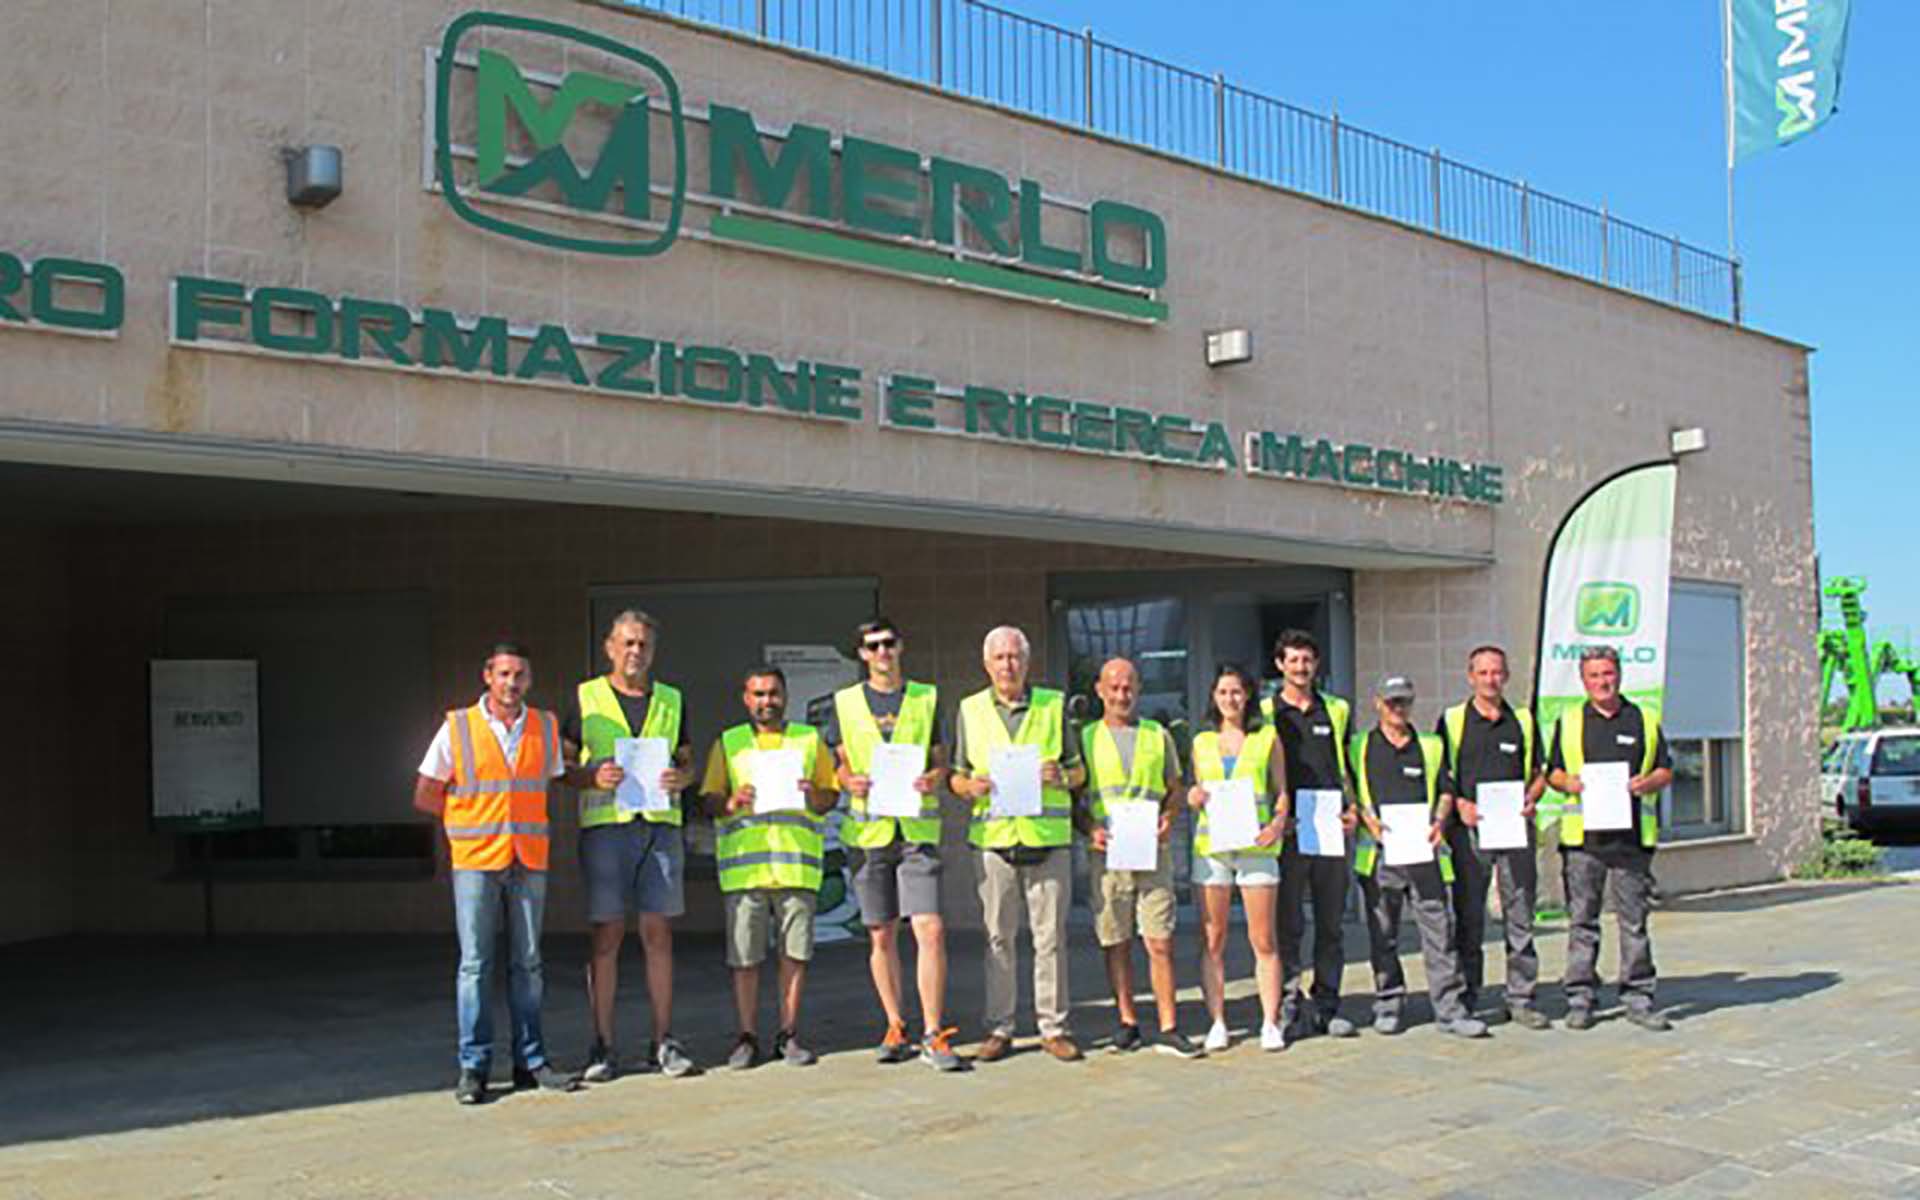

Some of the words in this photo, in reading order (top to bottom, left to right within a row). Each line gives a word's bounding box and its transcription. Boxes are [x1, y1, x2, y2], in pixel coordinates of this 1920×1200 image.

[708, 103, 1167, 288] MERLO
[176, 276, 862, 420] FORMAZIONE
[886, 374, 936, 428] E
[964, 385, 1237, 469] RICERCA
[1260, 431, 1503, 503] MACCHINE
